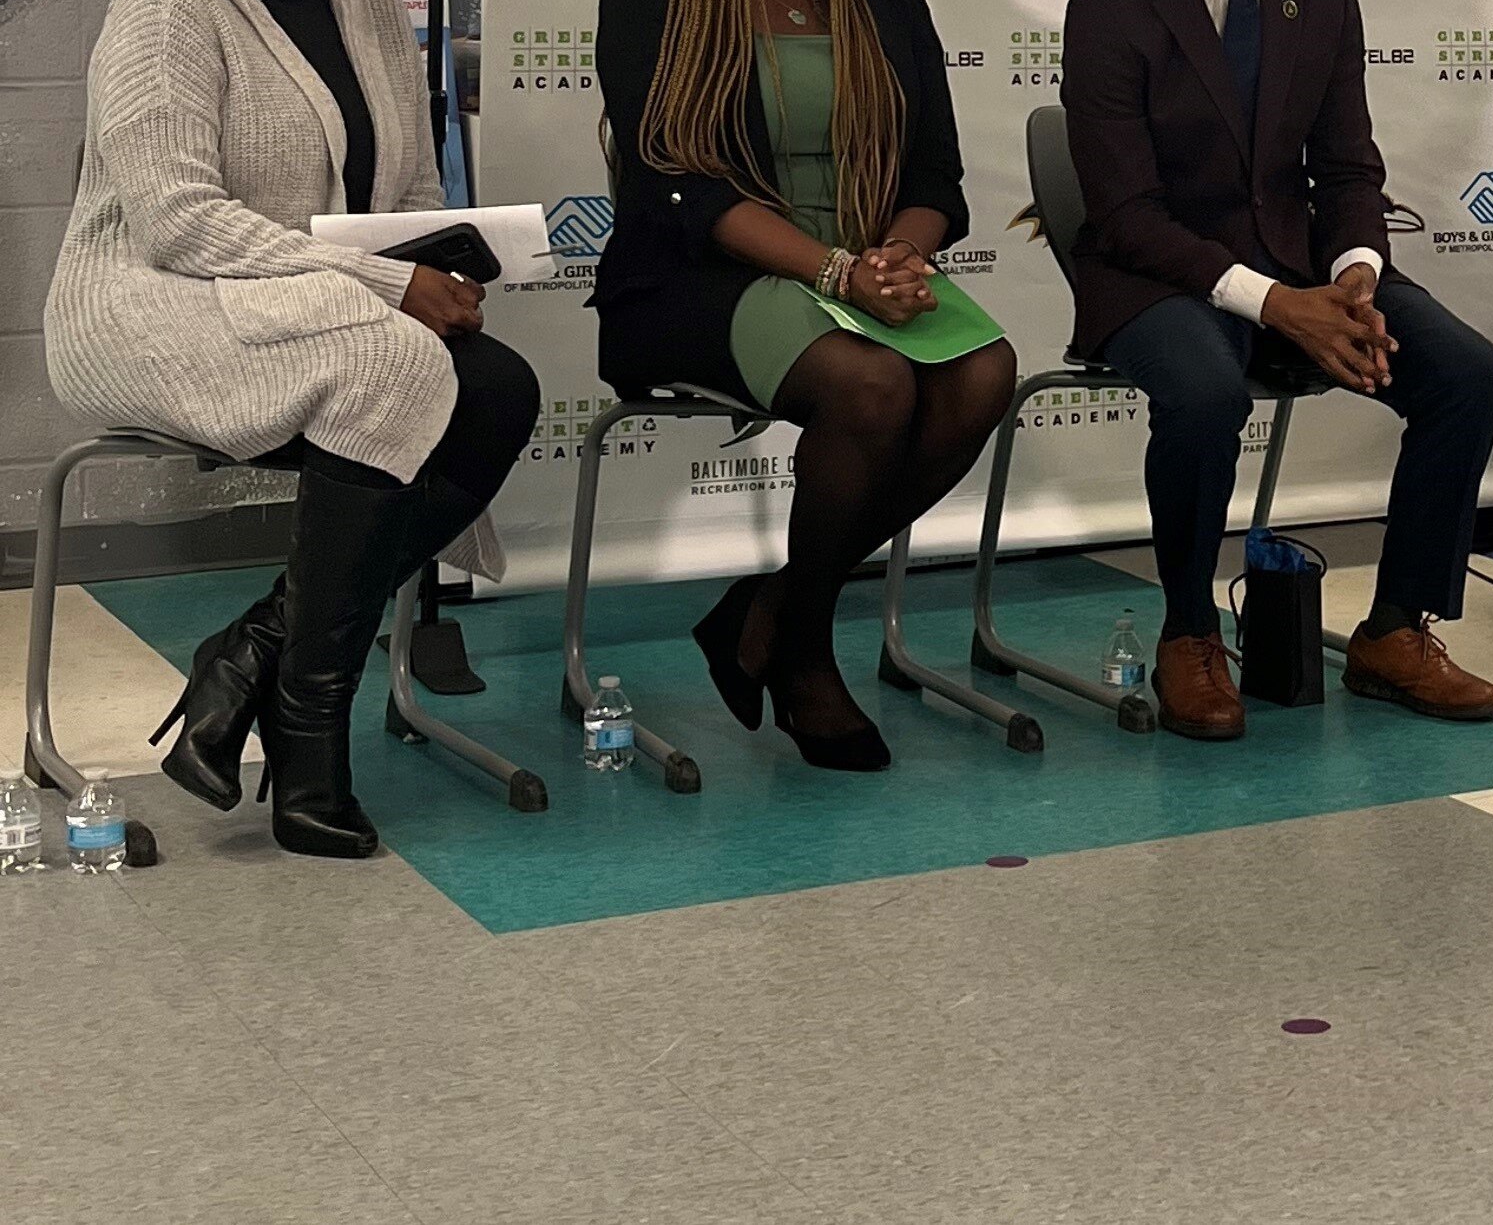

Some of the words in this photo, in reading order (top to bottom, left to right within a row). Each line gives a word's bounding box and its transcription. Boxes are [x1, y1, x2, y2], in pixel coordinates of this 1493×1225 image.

[1433, 231, 1466, 243] BOYS
[1469, 231, 1479, 242] &
[952, 250, 996, 264] CLUBS
[943, 264, 993, 276] BALTIMORE
[504, 284, 518, 292] OF
[1016, 409, 1137, 429] ACADEMY
[692, 457, 779, 480] BALTIMORE
[692, 482, 765, 495] RECREATION
